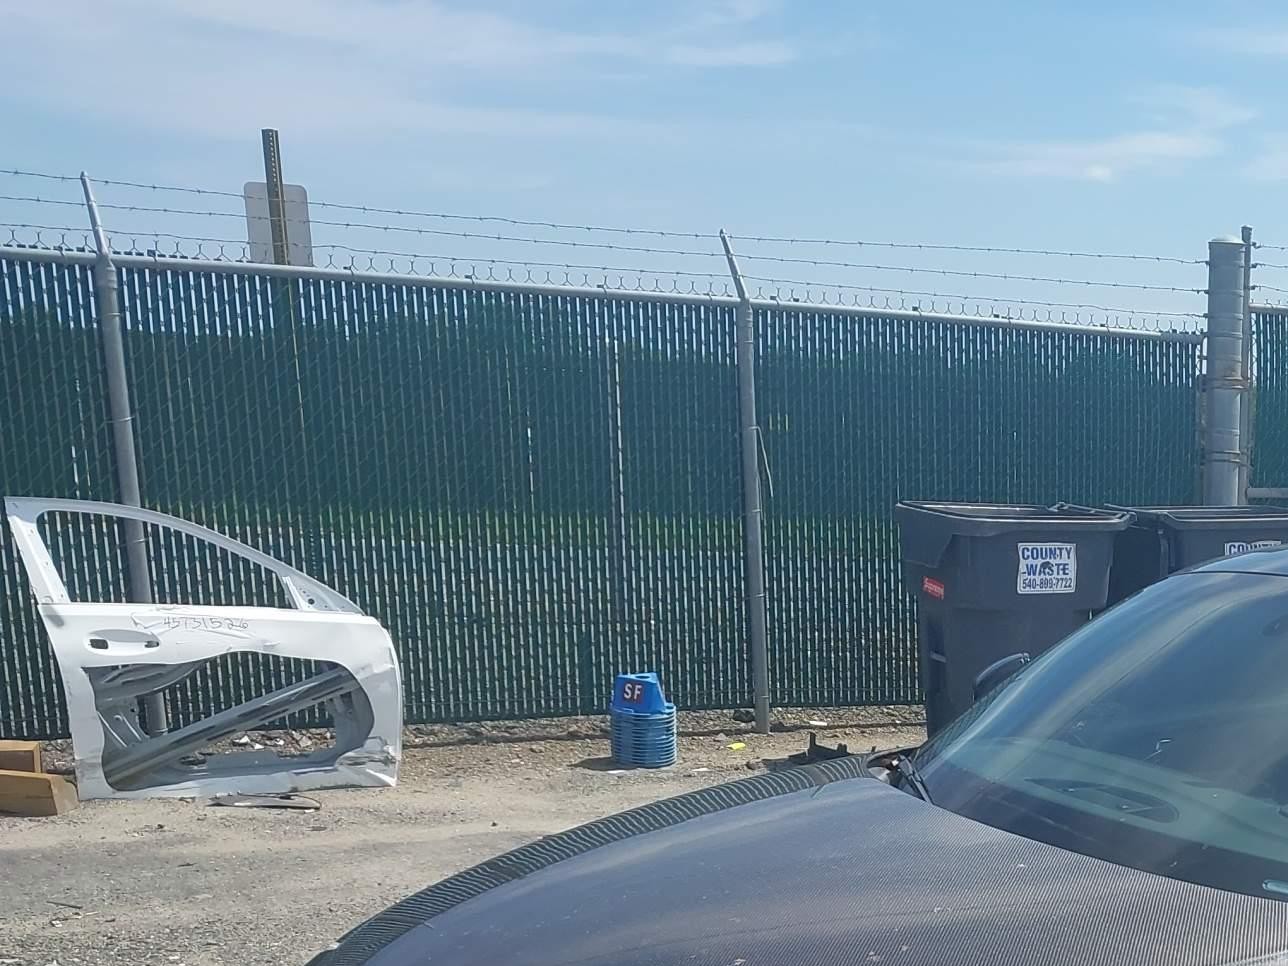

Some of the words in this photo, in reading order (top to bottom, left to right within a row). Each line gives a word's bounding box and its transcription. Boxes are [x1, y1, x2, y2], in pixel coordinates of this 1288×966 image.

[1022, 547, 1073, 560] COUNTY
[1025, 562, 1070, 577] WASTE
[623, 683, 643, 700] SF
